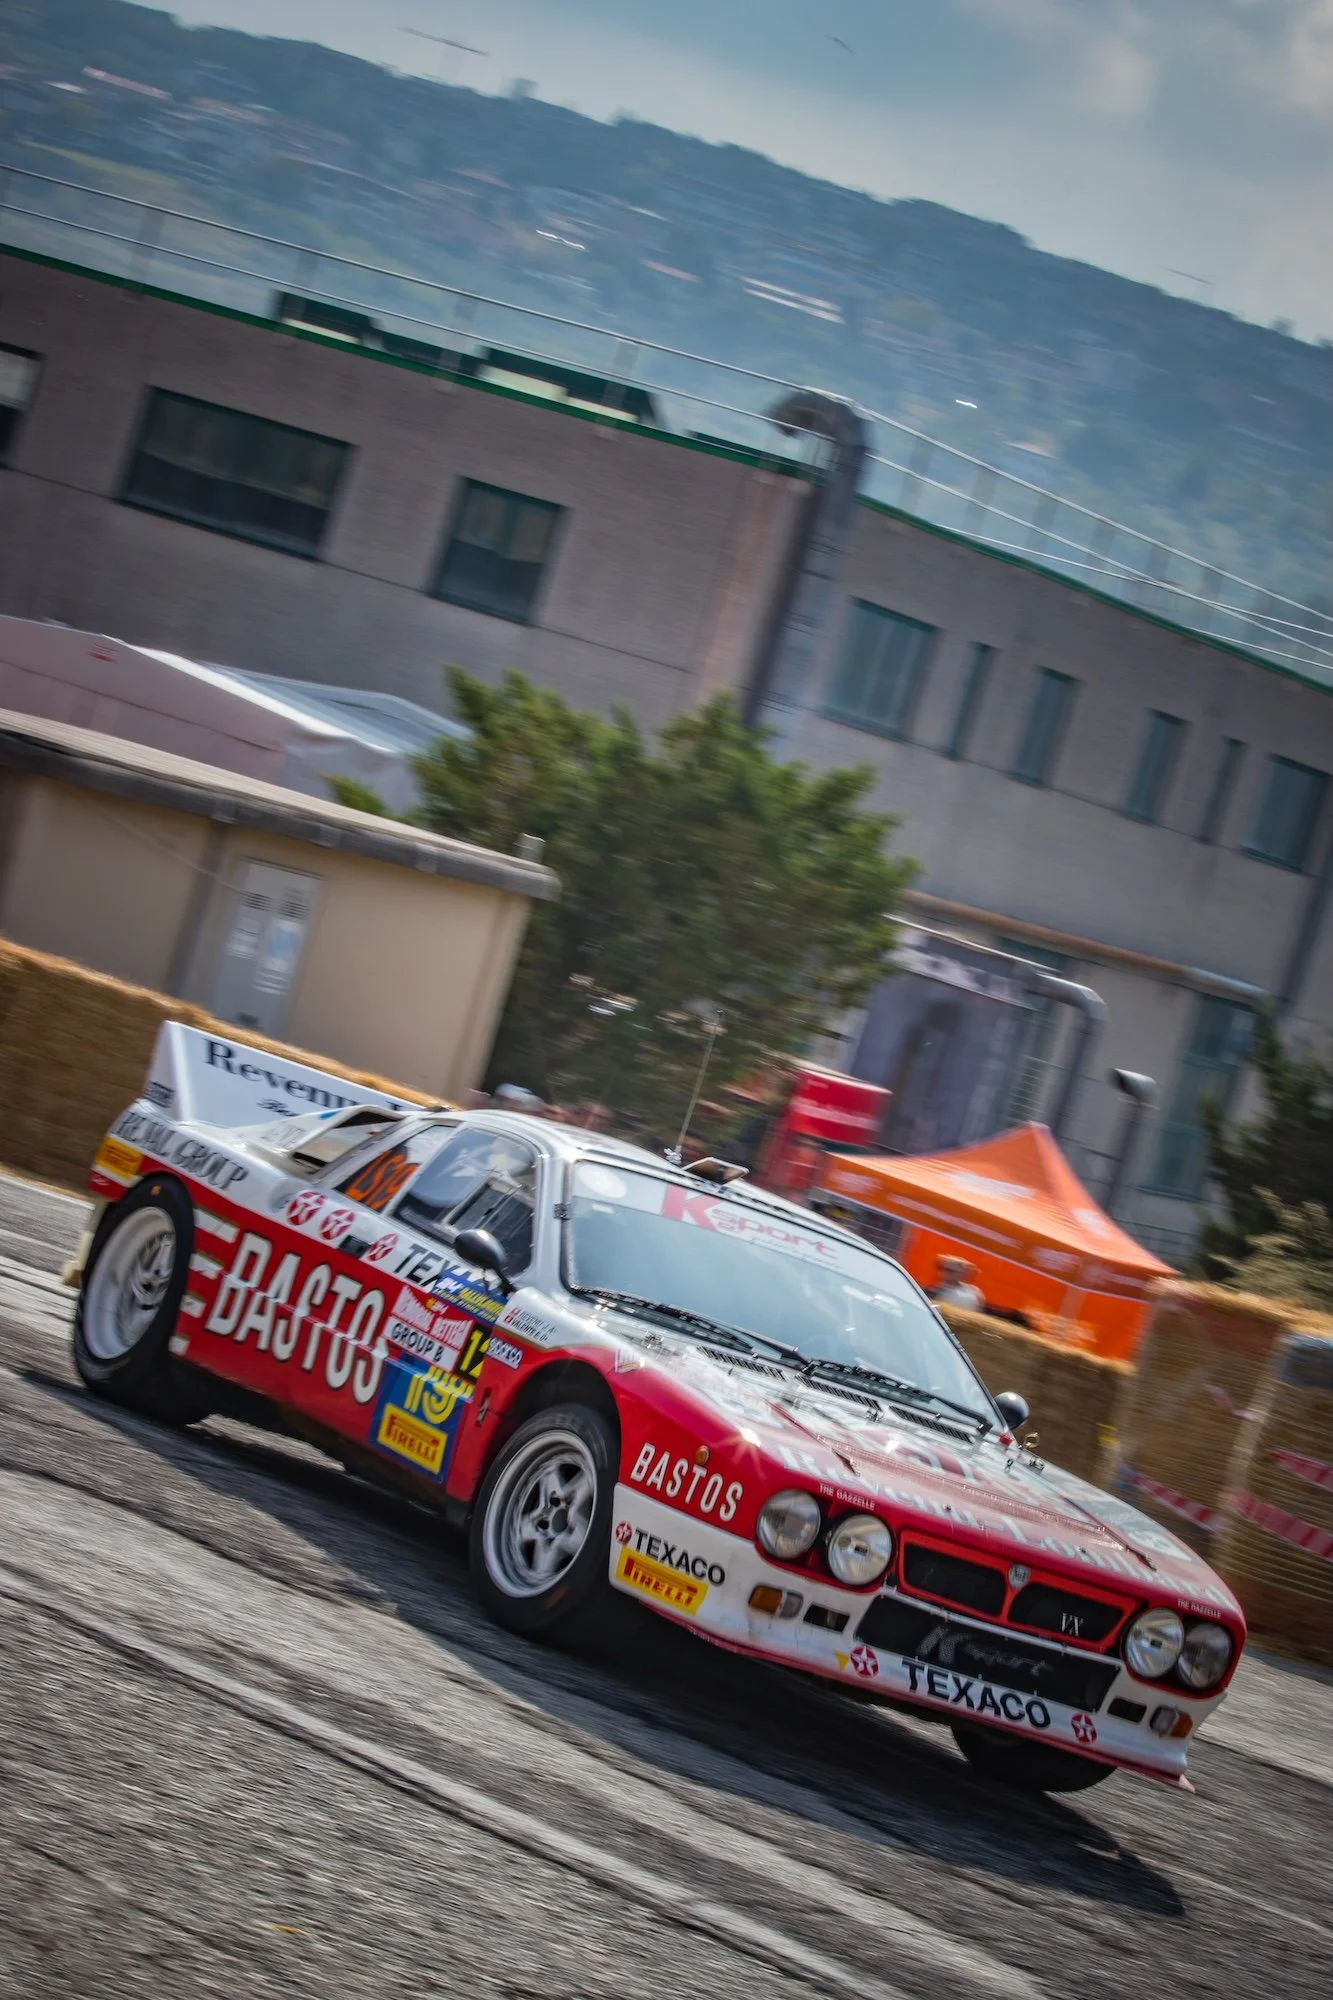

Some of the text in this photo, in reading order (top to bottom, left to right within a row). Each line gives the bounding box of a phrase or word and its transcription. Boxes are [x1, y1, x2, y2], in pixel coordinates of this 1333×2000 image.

[171, 1139, 249, 1190] GROUP
[205, 1231, 390, 1404] BASTOS
[391, 1322, 436, 1356] GROUP
[432, 1346, 445, 1362] B
[385, 1412, 441, 1463] PIRELLI
[630, 1442, 743, 1522] BASTOS
[819, 1482, 834, 1497] THE
[623, 1556, 699, 1607] PIRELLI
[635, 1527, 725, 1587] TEXACO
[1062, 1612, 1084, 1637] VX
[901, 1657, 1051, 1729] TEXACO
